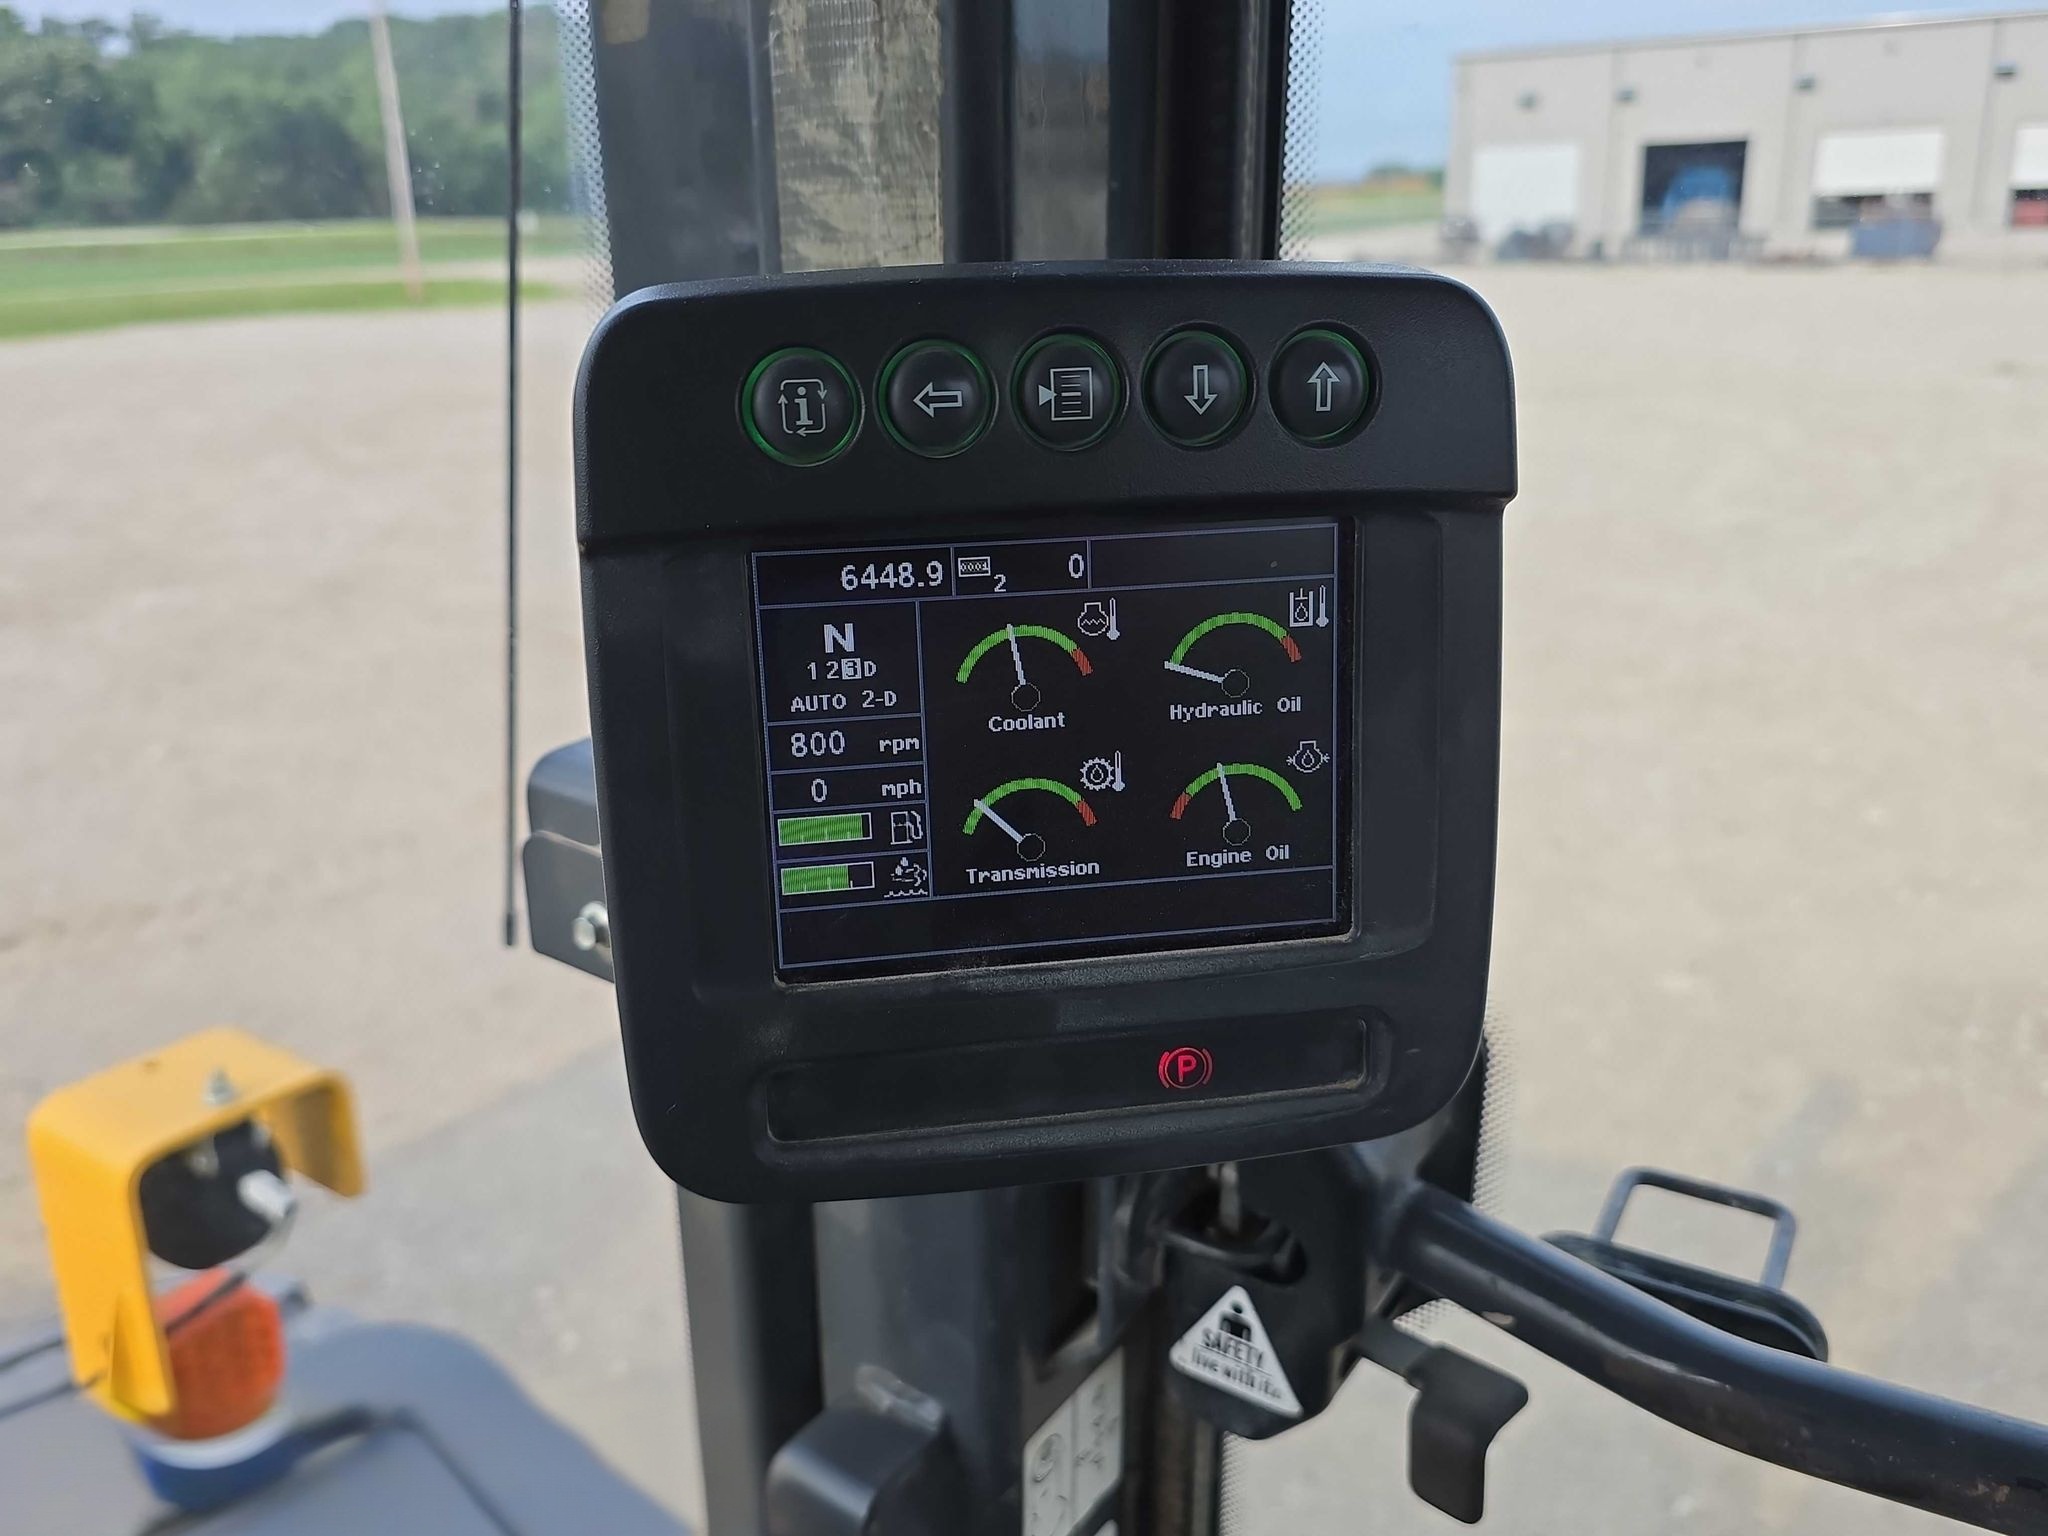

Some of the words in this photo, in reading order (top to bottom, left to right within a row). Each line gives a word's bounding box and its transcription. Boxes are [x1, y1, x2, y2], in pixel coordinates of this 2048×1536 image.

[841, 561, 943, 590] 6448.9
[1068, 553, 1084, 578] 0
[994, 574, 1006, 592] 2
[823, 623, 855, 653] N
[790, 694, 847, 712] AUTO
[862, 690, 897, 708] 2-D
[1170, 699, 1263, 722] Hydraulic
[1276, 697, 1301, 712] Oil
[988, 711, 1065, 732] Coolant
[790, 730, 845, 757] 800
[879, 737, 920, 755] rpm
[811, 779, 827, 802] 0
[881, 779, 922, 798] mph
[1186, 848, 1252, 868] Engine
[1265, 845, 1290, 861] Oil
[965, 860, 1100, 884] Transmission
[1178, 1055, 1197, 1082] P
